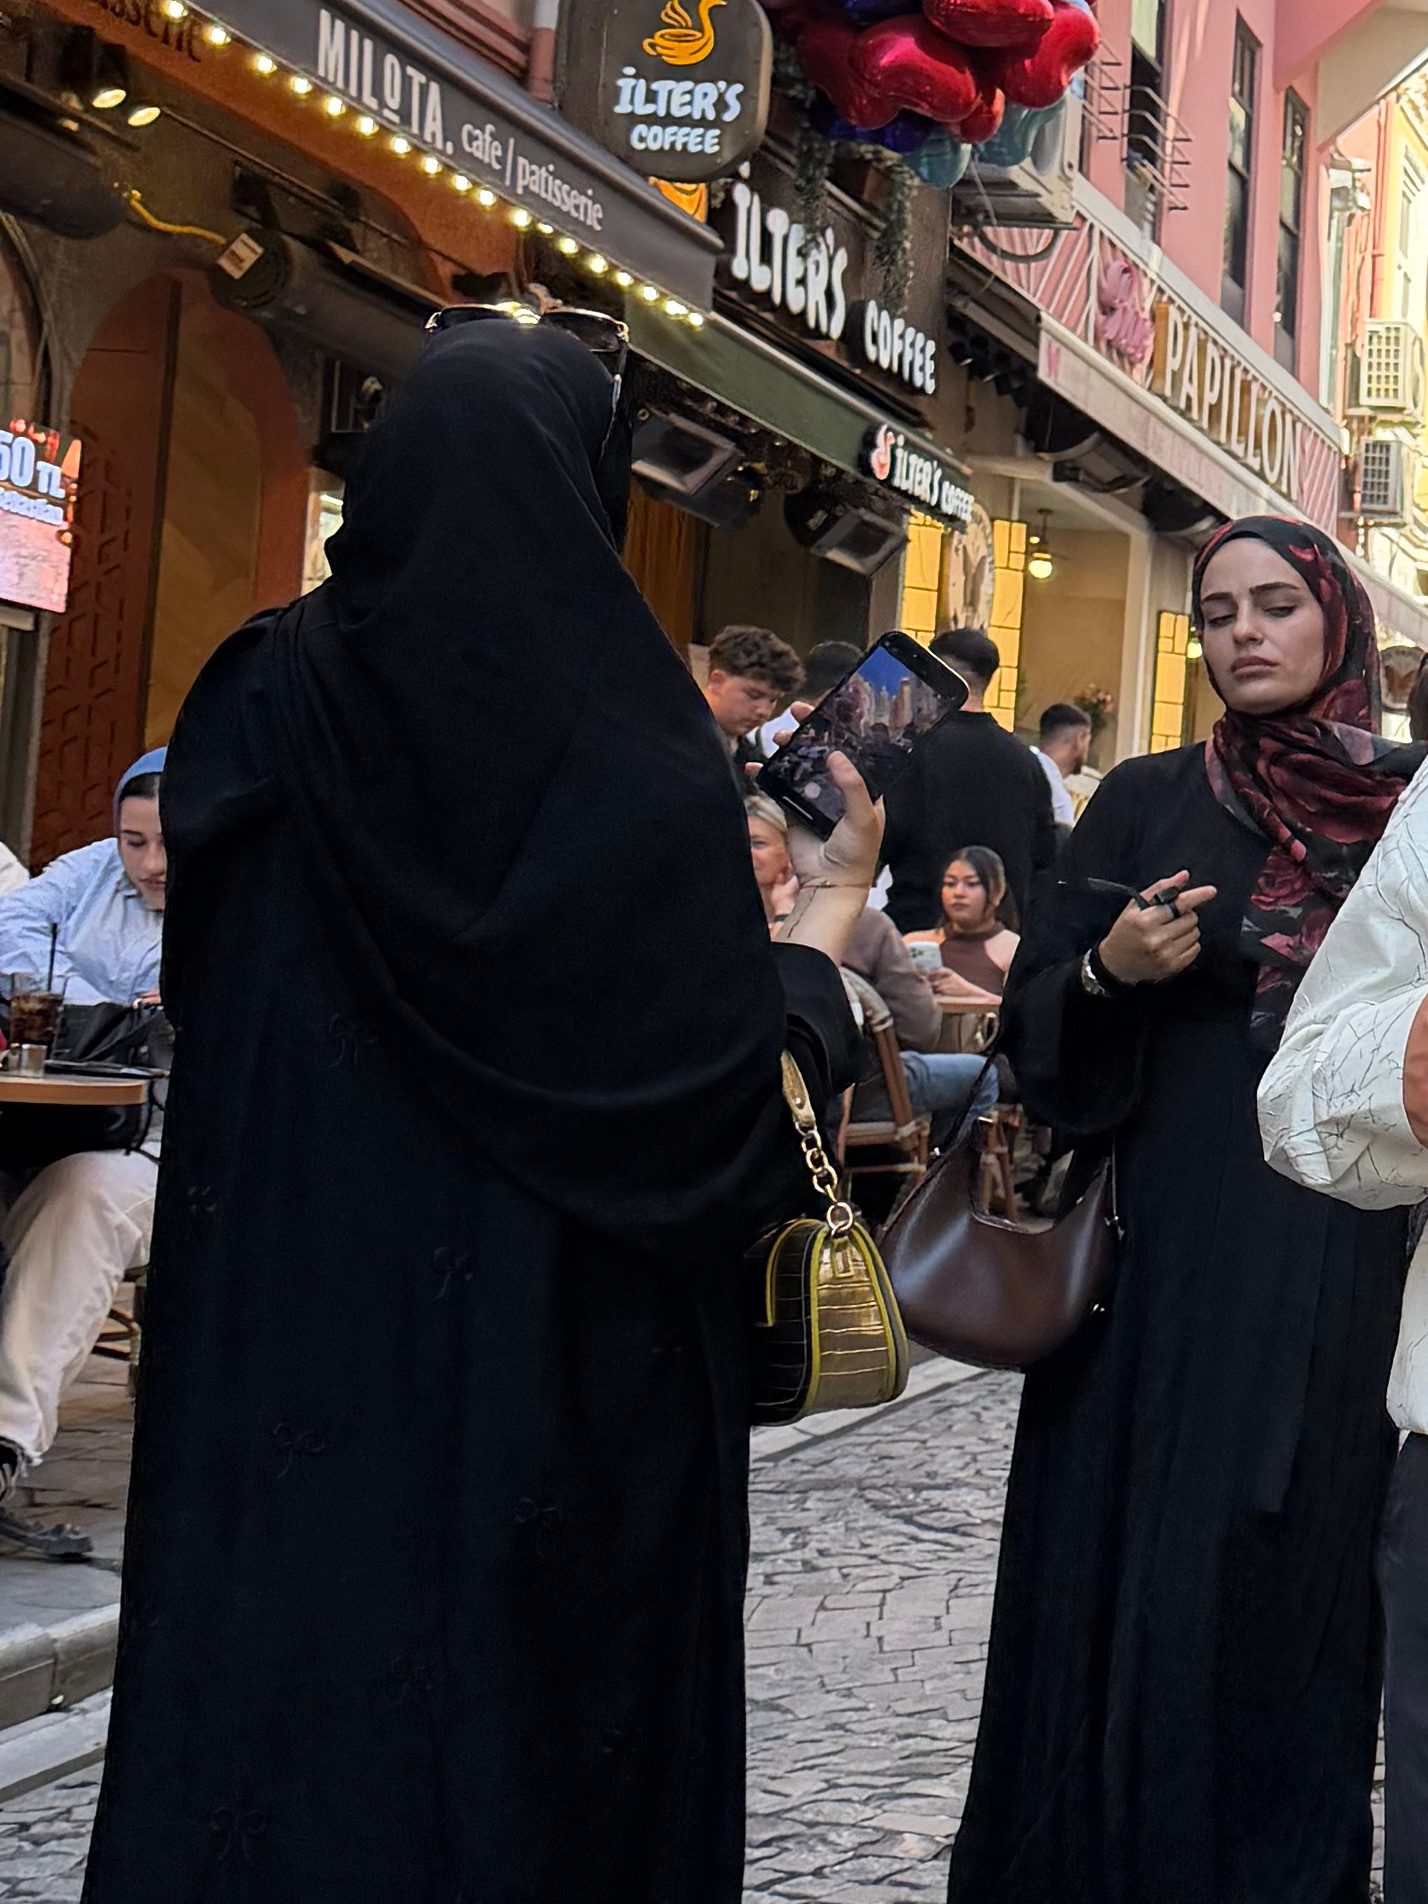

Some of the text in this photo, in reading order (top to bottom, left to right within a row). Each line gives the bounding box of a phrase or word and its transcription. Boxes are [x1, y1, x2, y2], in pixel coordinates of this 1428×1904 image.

[461, 123, 503, 170] cafe
[517, 156, 603, 230] patisserie
[630, 124, 721, 154] COFFEE
[864, 299, 936, 395] COFFEE
[1164, 304, 1302, 501] PAPILLON
[36, 461, 65, 498] TL
